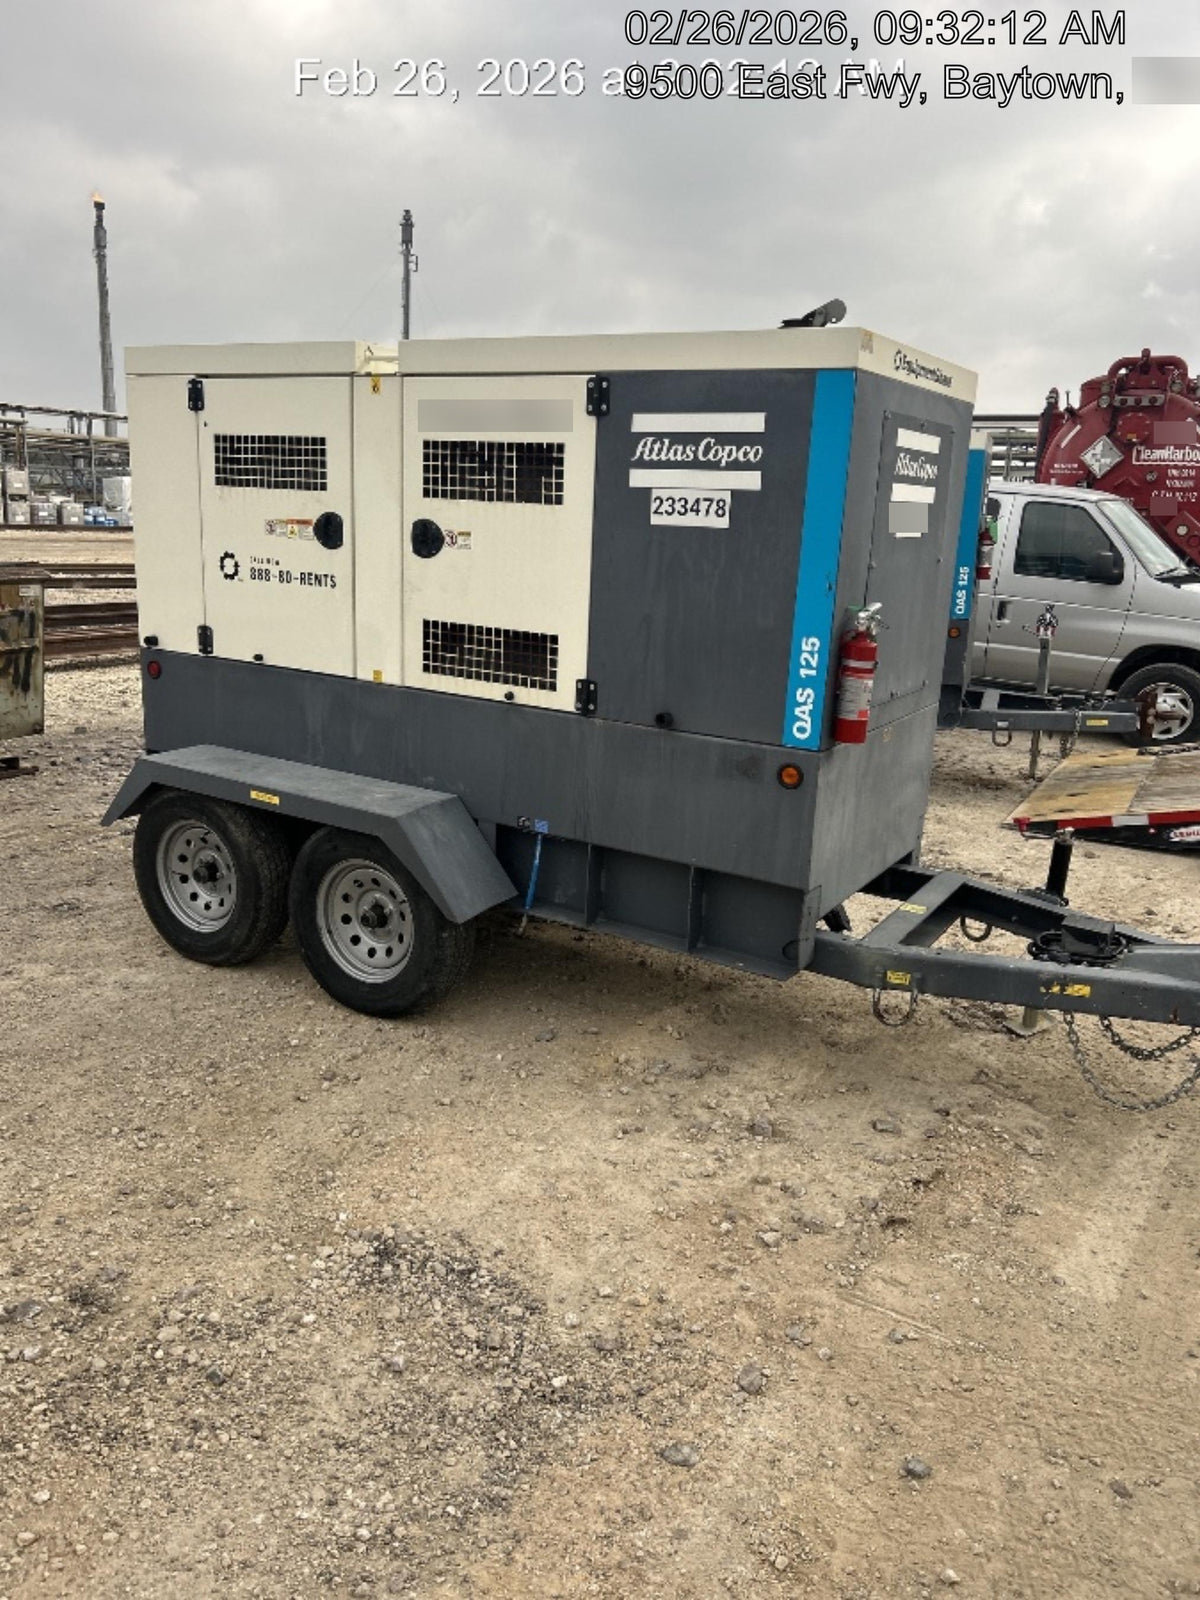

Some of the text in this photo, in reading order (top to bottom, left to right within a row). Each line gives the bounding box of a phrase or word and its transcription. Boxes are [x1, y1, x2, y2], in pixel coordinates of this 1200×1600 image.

[631, 436, 763, 467] Atlas Copco
[652, 495, 727, 518] 233478
[799, 636, 821, 679] 125
